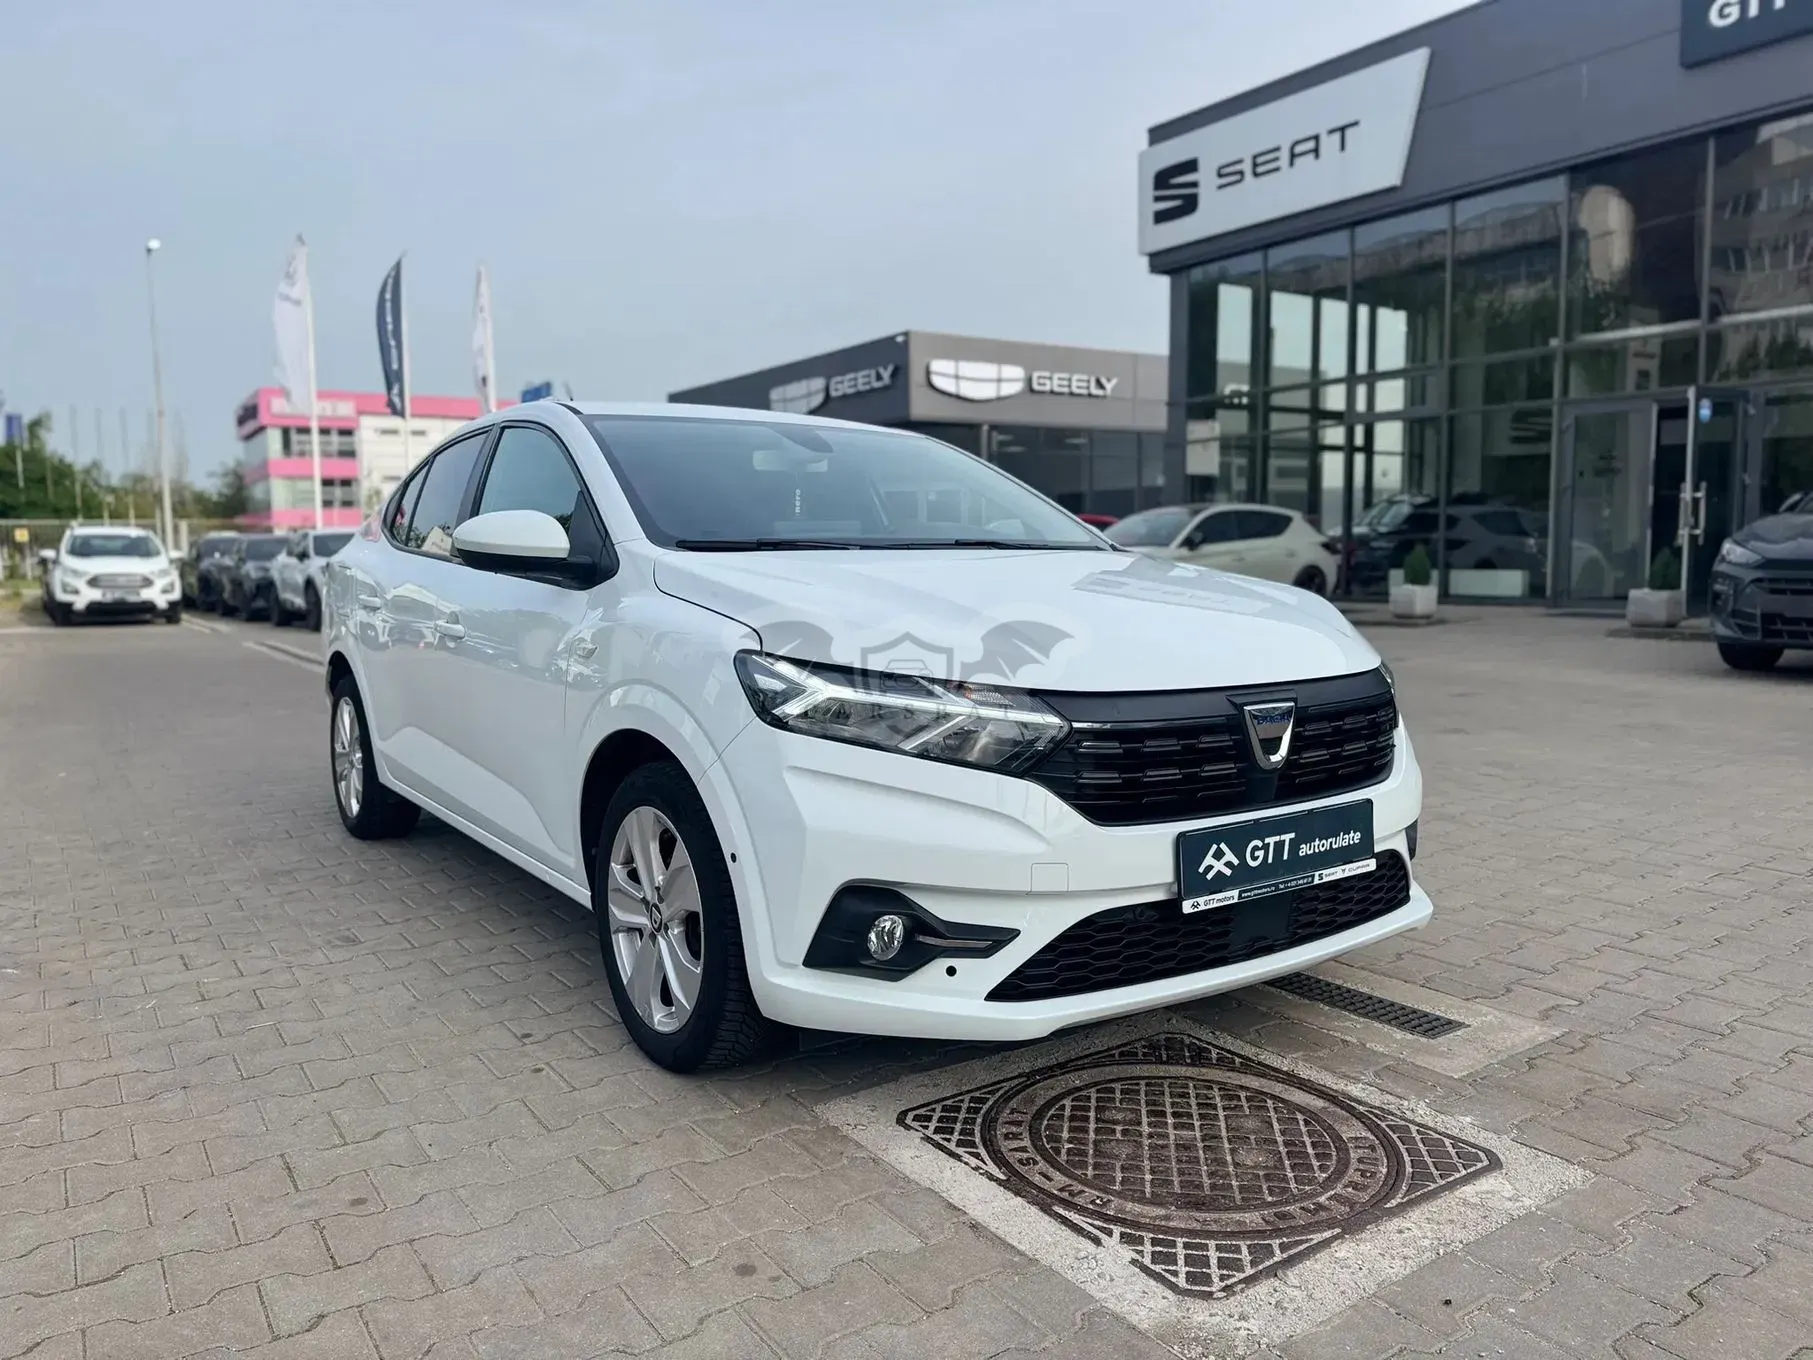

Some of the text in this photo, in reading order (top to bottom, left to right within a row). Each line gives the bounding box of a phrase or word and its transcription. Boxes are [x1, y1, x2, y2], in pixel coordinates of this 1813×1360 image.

[1216, 120, 1361, 190] SEAT
[828, 364, 896, 398] GEELY
[1031, 371, 1119, 397] GEELY
[1245, 830, 1361, 867] GTT autorulate
[1203, 897, 1216, 907] GTT
